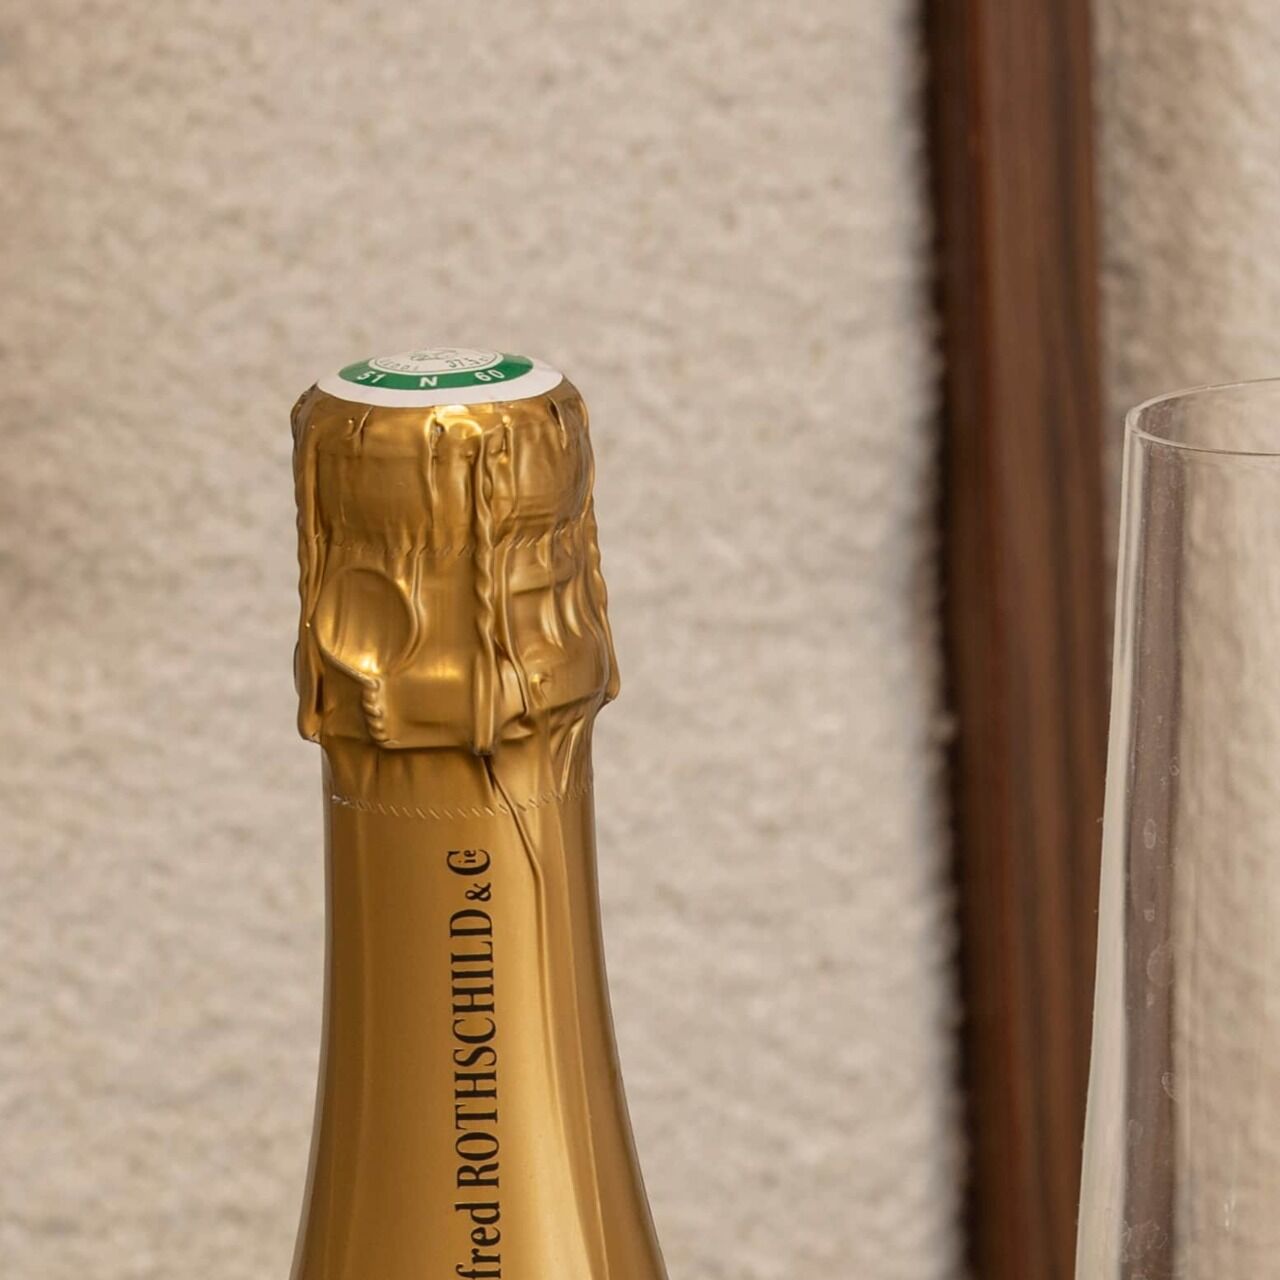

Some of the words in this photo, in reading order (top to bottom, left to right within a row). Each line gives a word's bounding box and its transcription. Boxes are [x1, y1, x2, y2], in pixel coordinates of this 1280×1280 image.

[356, 370, 387, 383] 51
[419, 376, 438, 388] N
[474, 370, 505, 383] 60
[449, 908, 499, 1190] ROTHSCHILD
